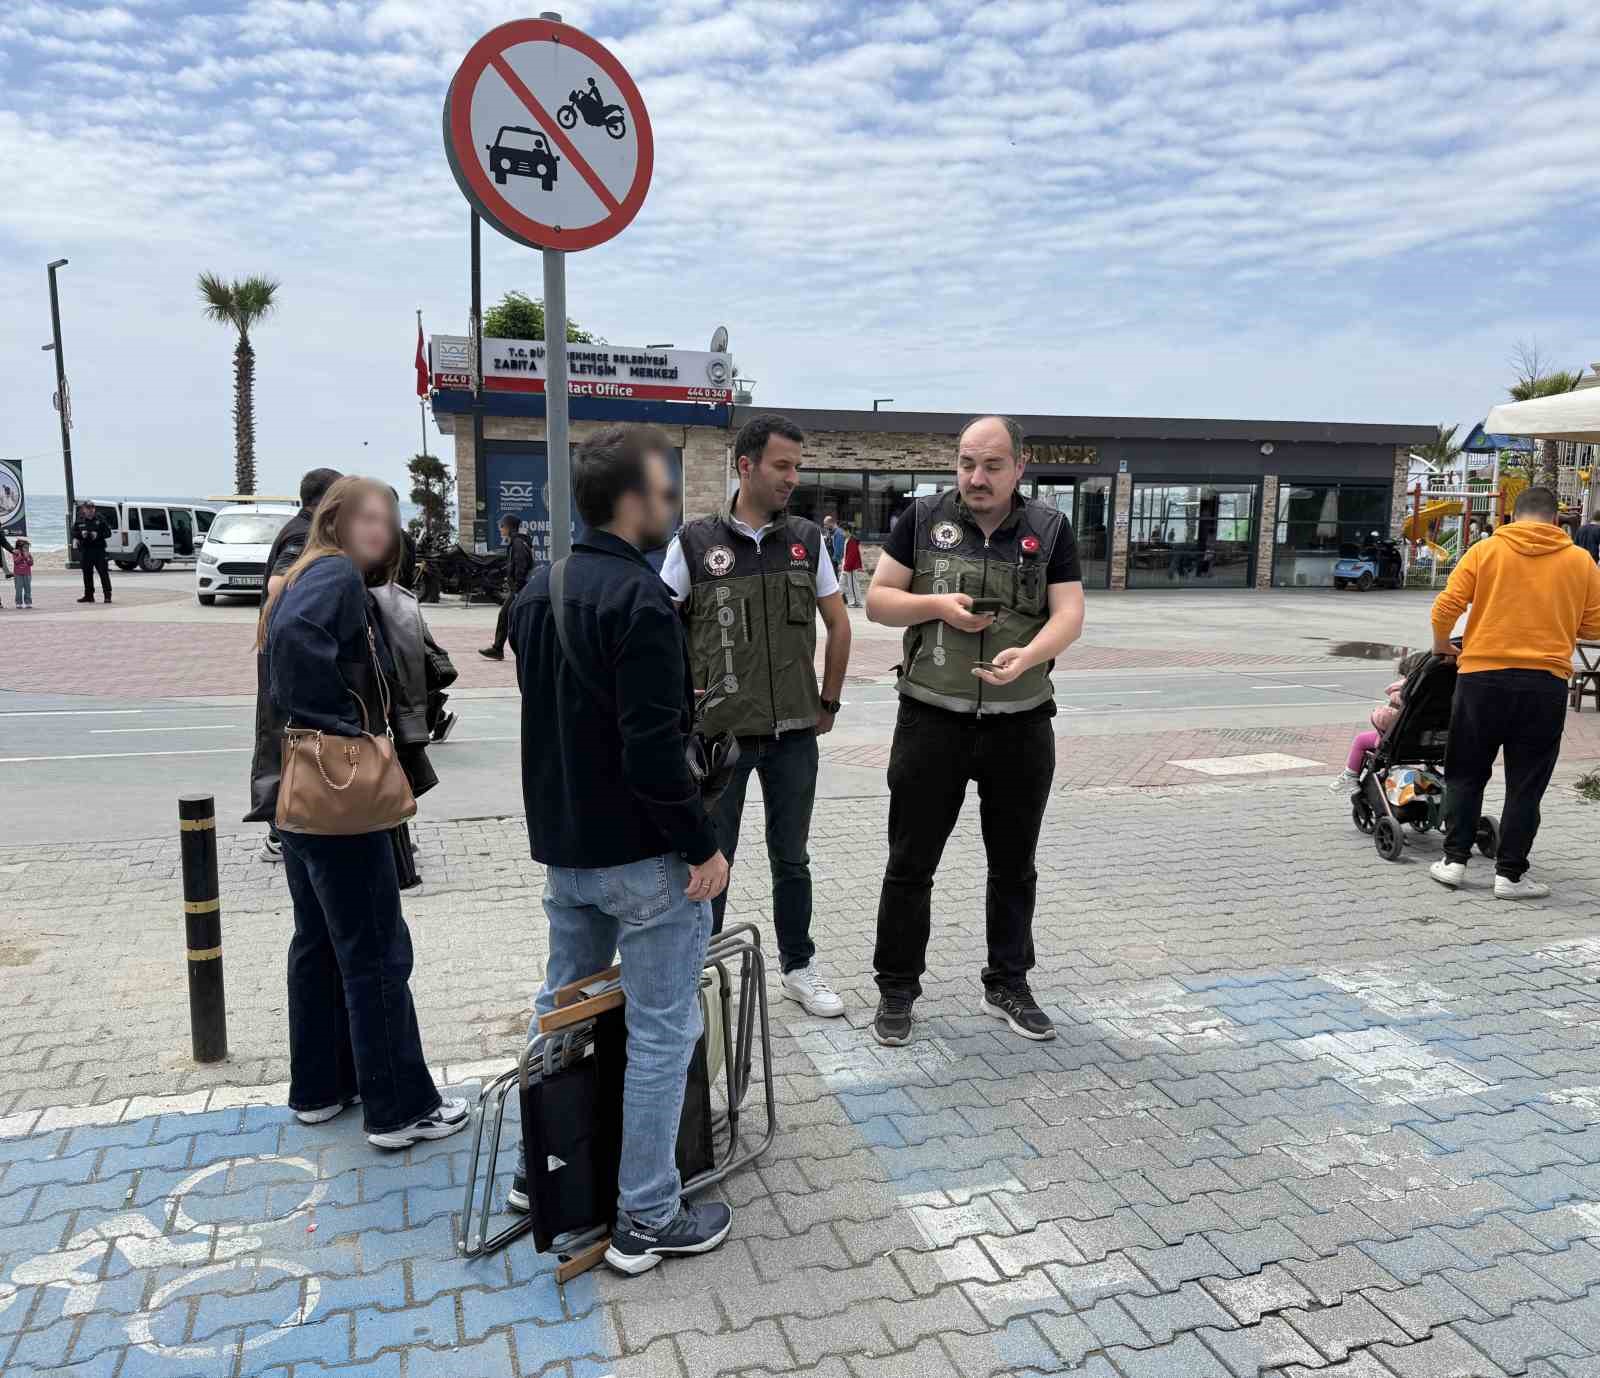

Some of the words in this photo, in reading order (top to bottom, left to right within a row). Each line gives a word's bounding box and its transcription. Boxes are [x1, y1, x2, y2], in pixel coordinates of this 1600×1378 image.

[508, 347, 527, 358] T.C.
[494, 358, 537, 371] ZABITA
[630, 366, 678, 379] MERKEZİ
[568, 382, 592, 394] tact
[596, 383, 632, 397] Office
[688, 387, 703, 396] 444
[712, 389, 727, 397] 340
